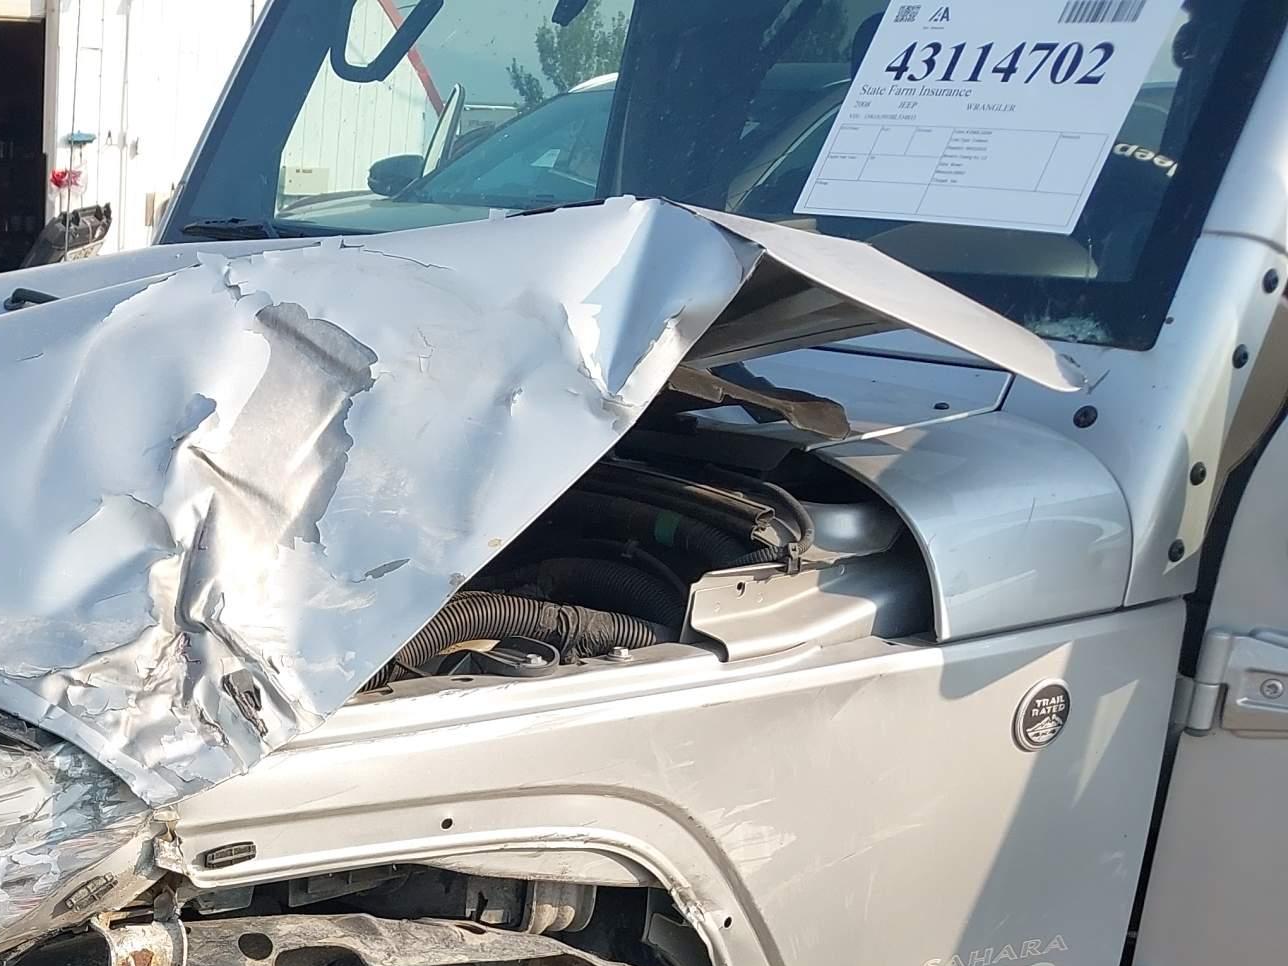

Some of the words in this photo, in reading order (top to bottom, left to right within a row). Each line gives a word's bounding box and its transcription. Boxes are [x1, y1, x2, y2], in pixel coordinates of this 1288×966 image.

[885, 41, 1115, 85] 43114702
[859, 84, 886, 96] State
[888, 85, 917, 97] Farm
[918, 86, 972, 97] Insurance
[966, 103, 1016, 112] WRANGLER
[1035, 695, 1065, 708] TRAIL
[1032, 703, 1065, 717] RATED
